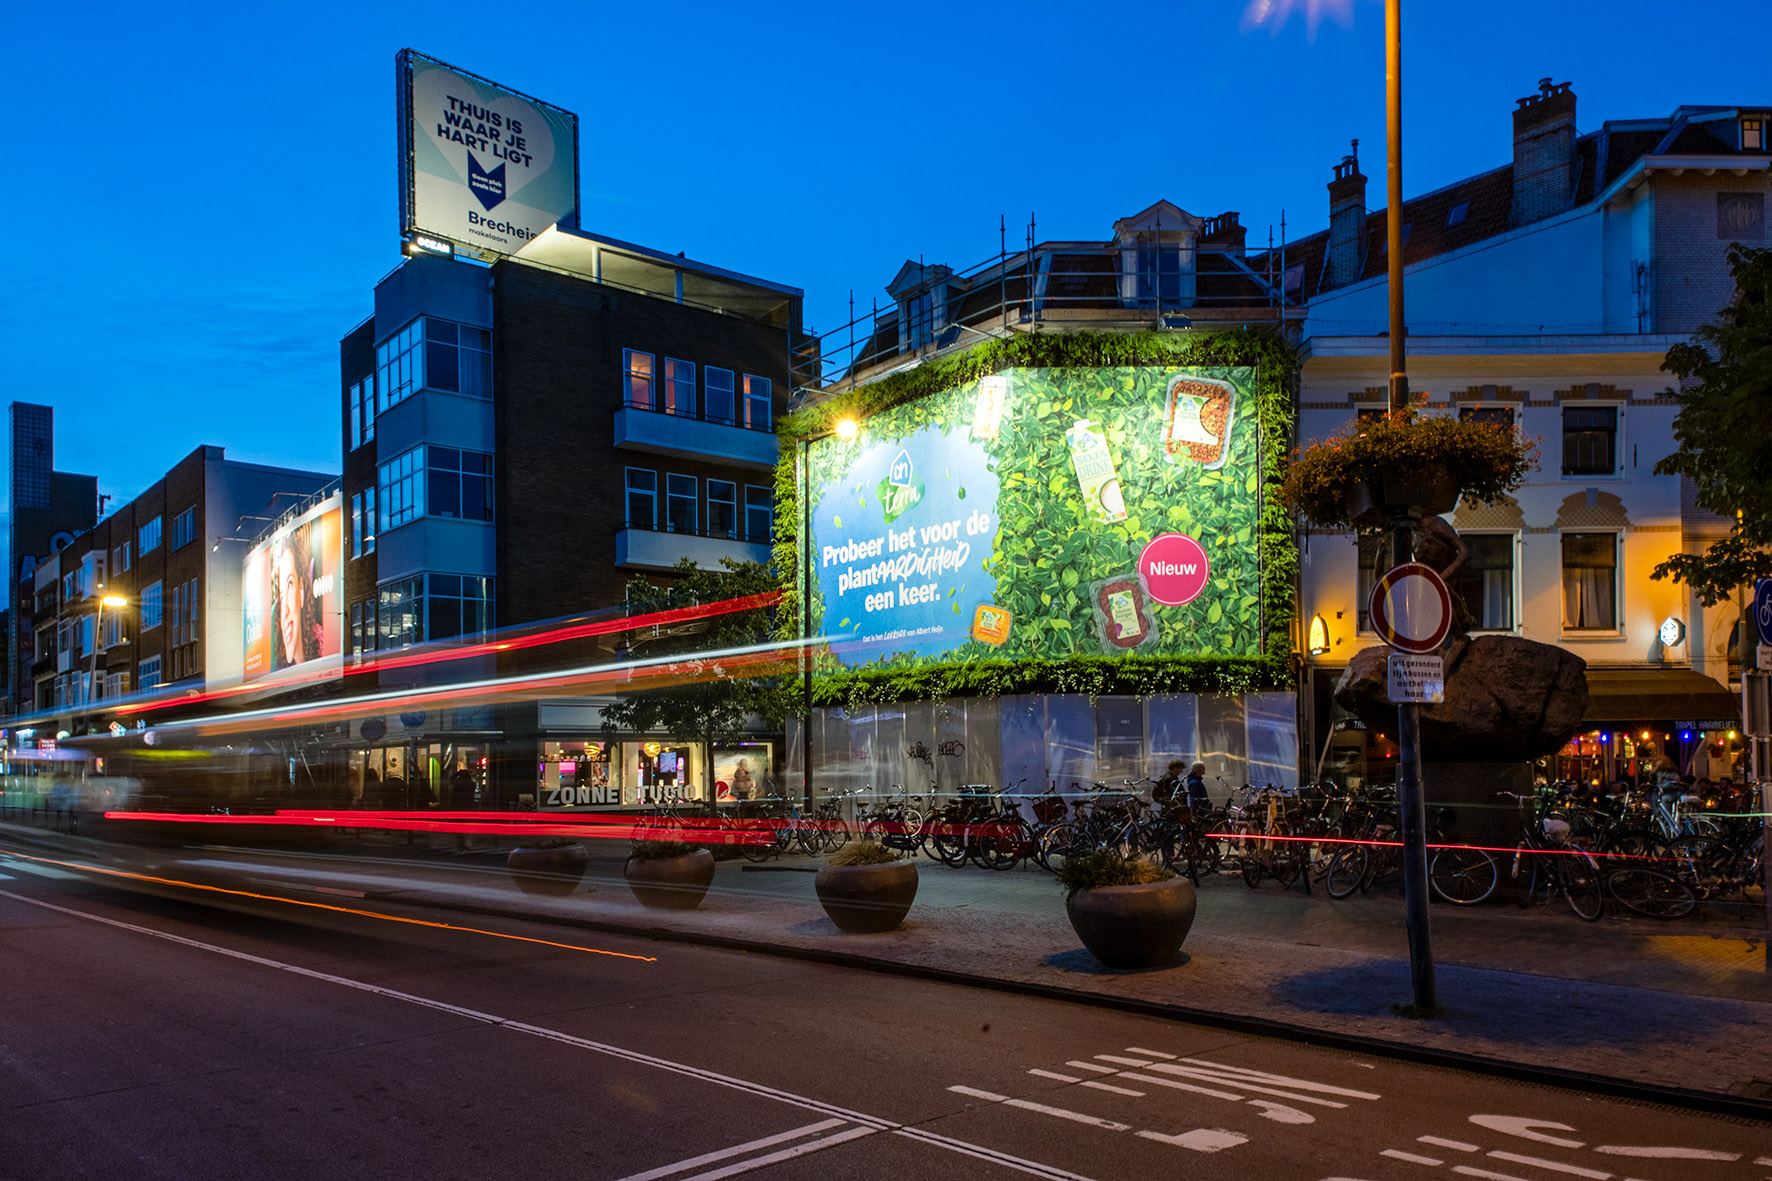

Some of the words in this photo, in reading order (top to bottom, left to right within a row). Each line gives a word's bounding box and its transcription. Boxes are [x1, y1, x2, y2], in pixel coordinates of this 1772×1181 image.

[447, 94, 502, 127] THUIS
[506, 117, 522, 134] IS
[443, 109, 501, 142] WAAR
[505, 134, 526, 151] JE
[437, 123, 489, 152] HART
[493, 143, 533, 168] LIGT
[468, 210, 538, 241] Brecheis
[469, 228, 508, 244] makelaars
[1076, 450, 1107, 464] SOJA
[1078, 459, 1112, 479] DRINK
[883, 486, 920, 514] terra
[823, 536, 884, 568] Probeer
[888, 526, 916, 553] het
[920, 518, 961, 545] voor
[966, 509, 990, 536] de
[1150, 561, 1197, 576] Nieuw
[865, 587, 894, 613] een
[899, 582, 940, 608] keer.
[1393, 660, 1440, 668] uitgezonderd
[1393, 670, 1431, 678] lijnbussen
[1675, 720, 1697, 730] TRIPEL
[547, 786, 619, 805] ZONNE
[625, 784, 697, 804] STUDIO
